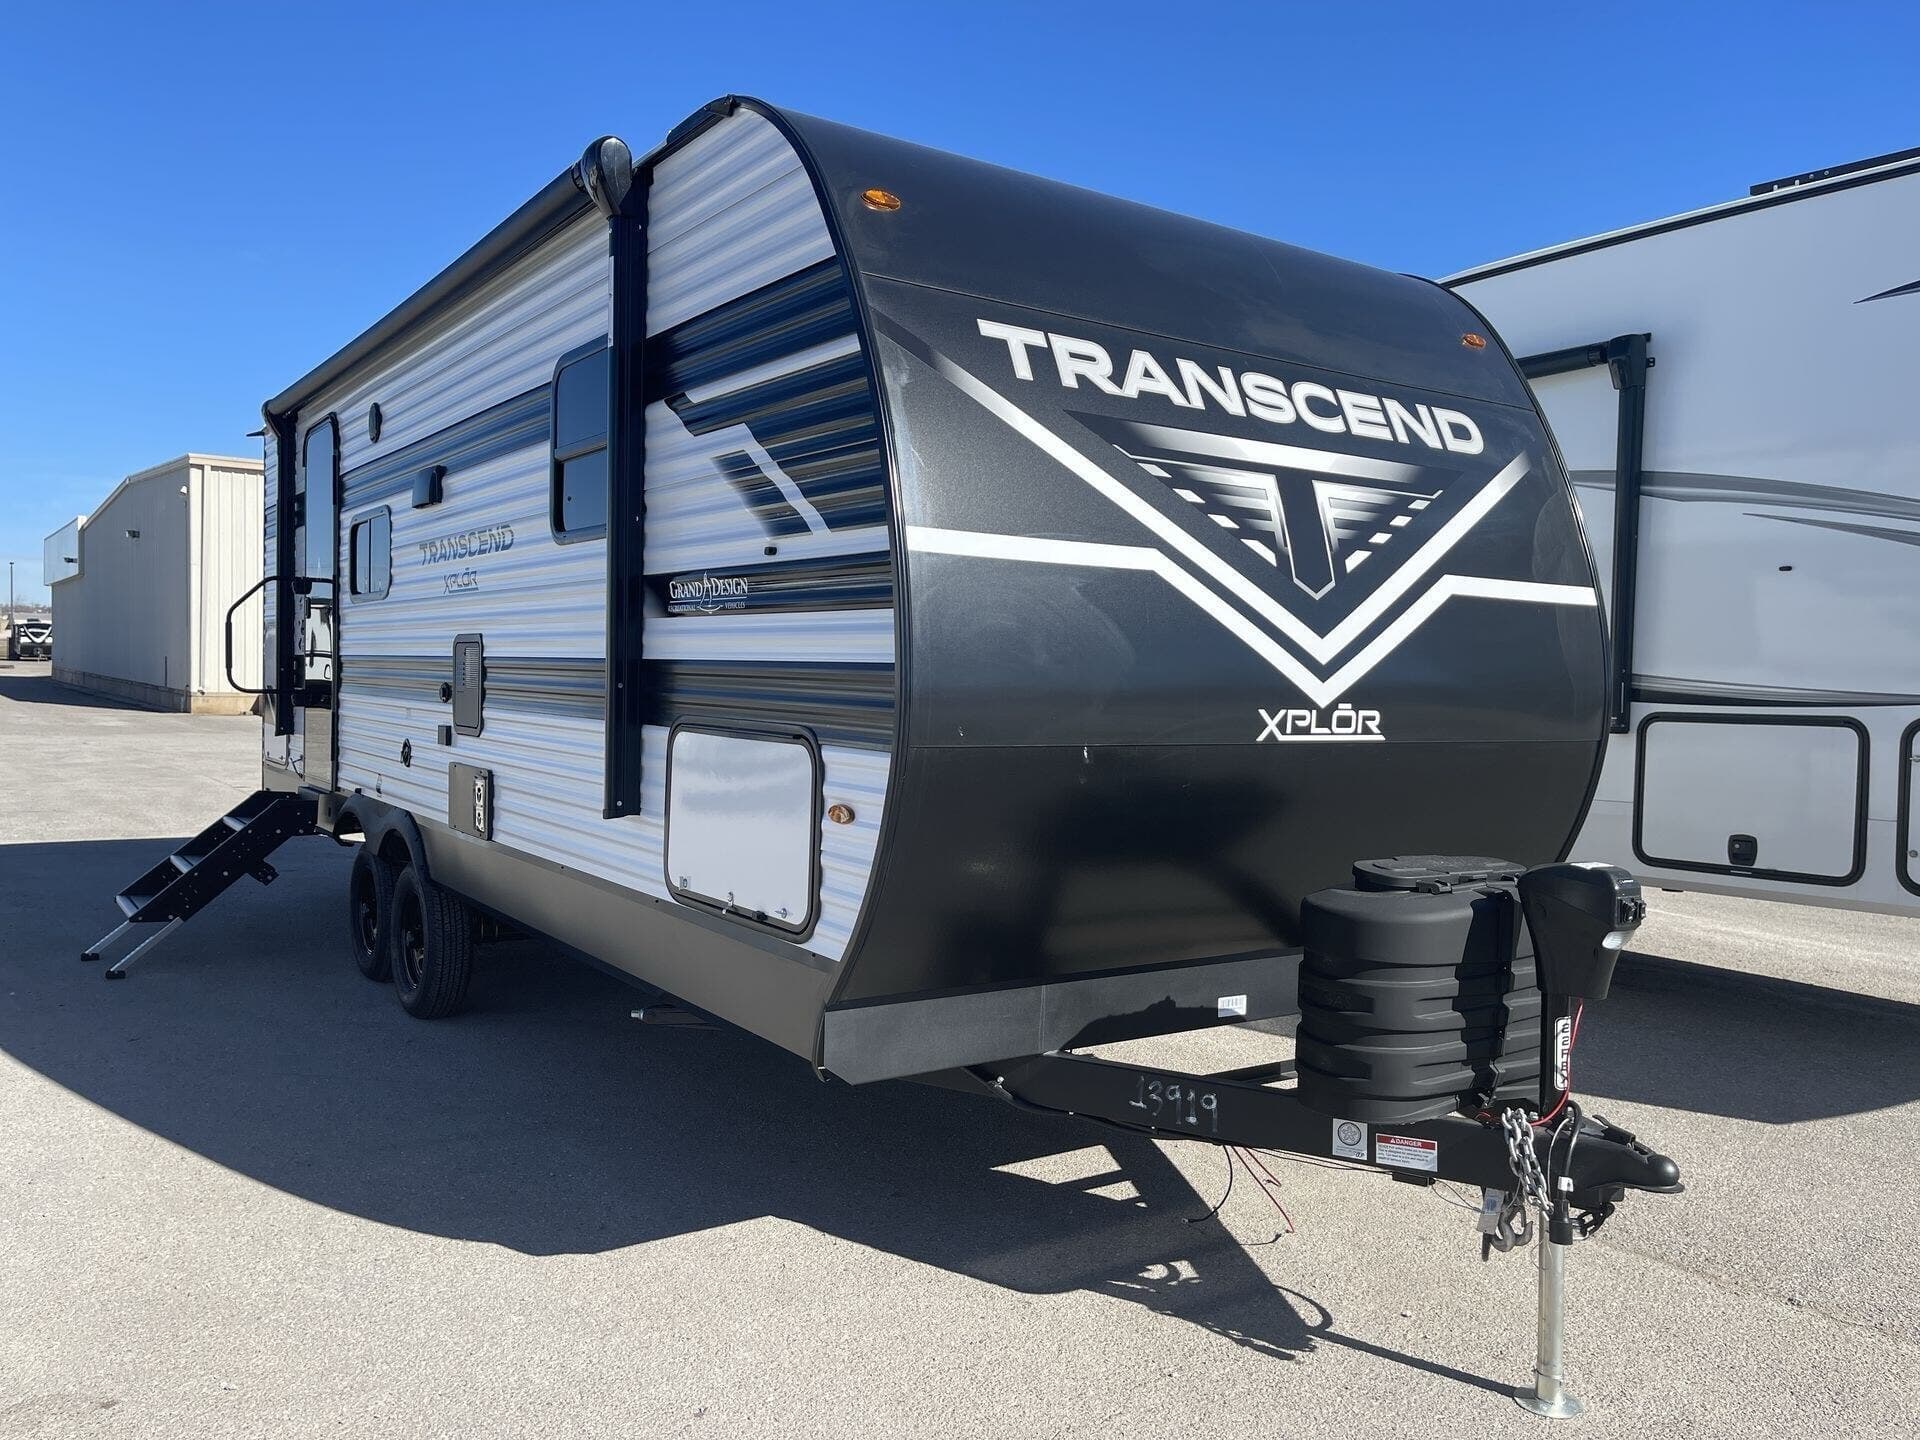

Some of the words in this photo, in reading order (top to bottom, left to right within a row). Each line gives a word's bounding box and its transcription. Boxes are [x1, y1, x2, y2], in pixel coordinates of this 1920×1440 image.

[976, 318, 1485, 455] TRANSCEND
[419, 524, 514, 566] TRANSCEND
[669, 581, 703, 598] GRAND
[709, 577, 748, 596] DESIGN
[1128, 1075, 1218, 1132] 13919
[1395, 1138, 1423, 1148] DANGER
